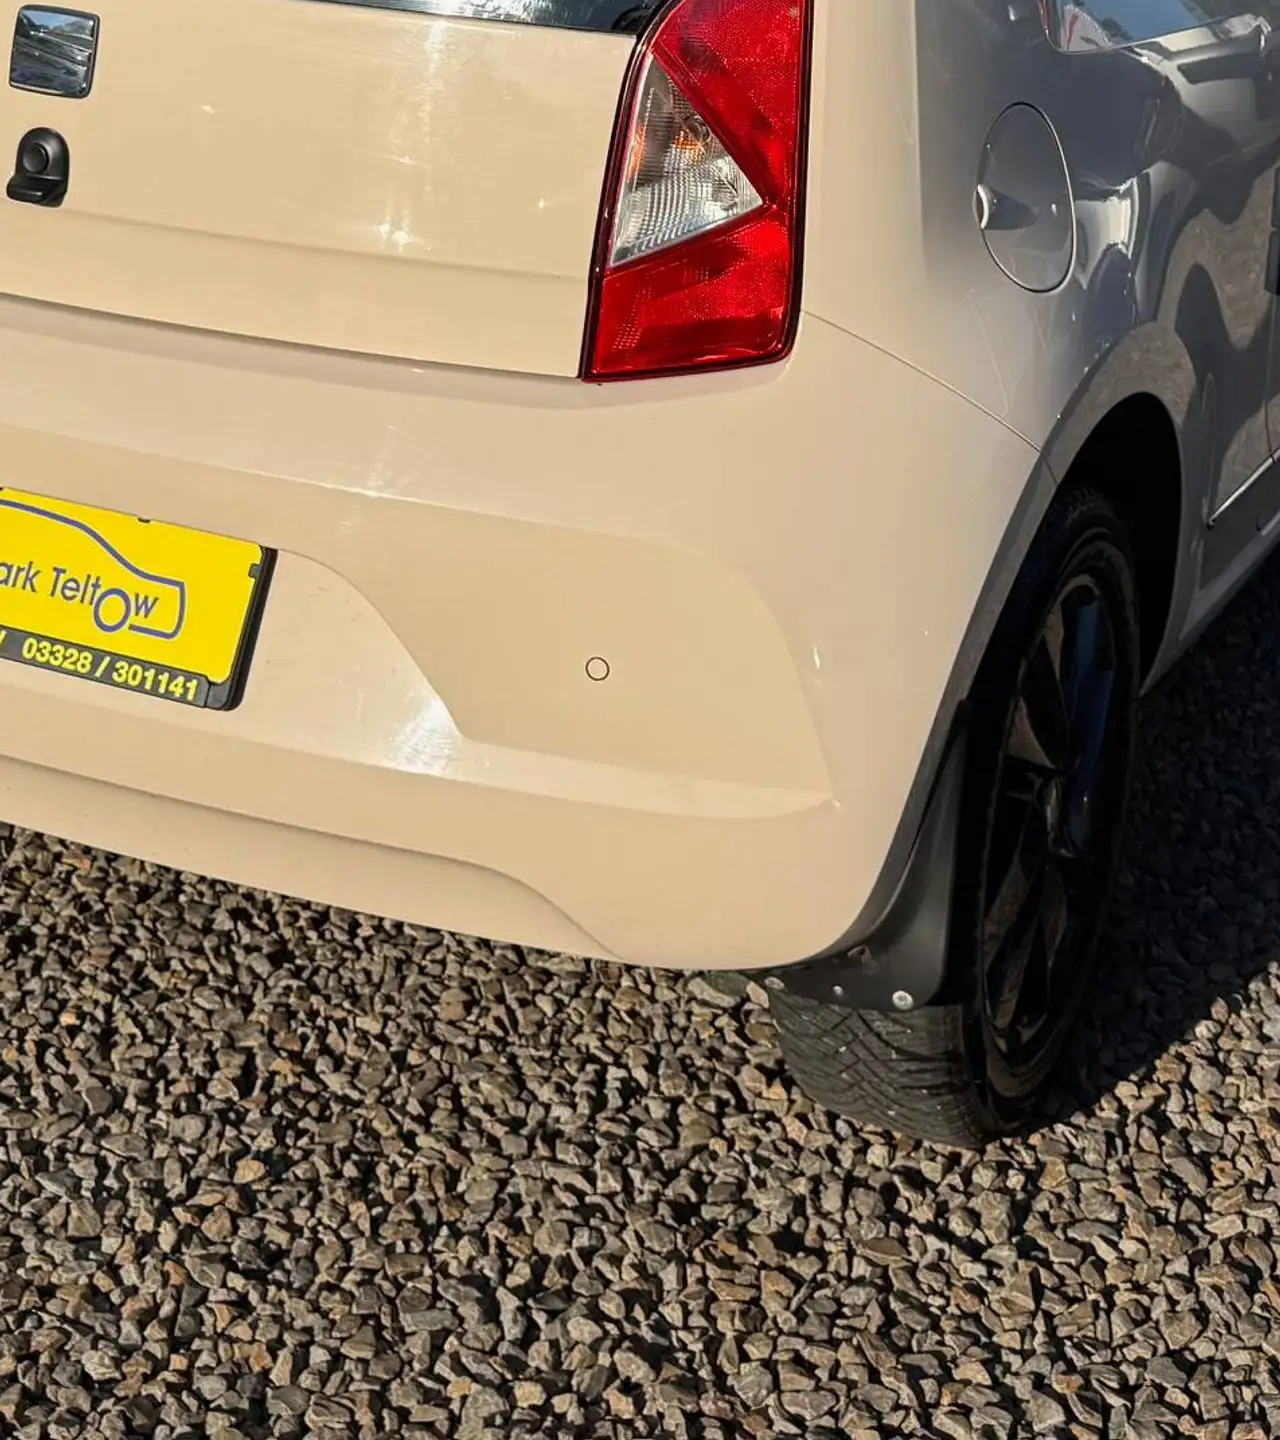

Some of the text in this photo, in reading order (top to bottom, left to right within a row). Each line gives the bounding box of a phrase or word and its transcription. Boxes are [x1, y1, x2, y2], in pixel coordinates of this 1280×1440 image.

[22, 637, 91, 673] 03328
[95, 655, 108, 677] /
[112, 660, 197, 701] 301141
